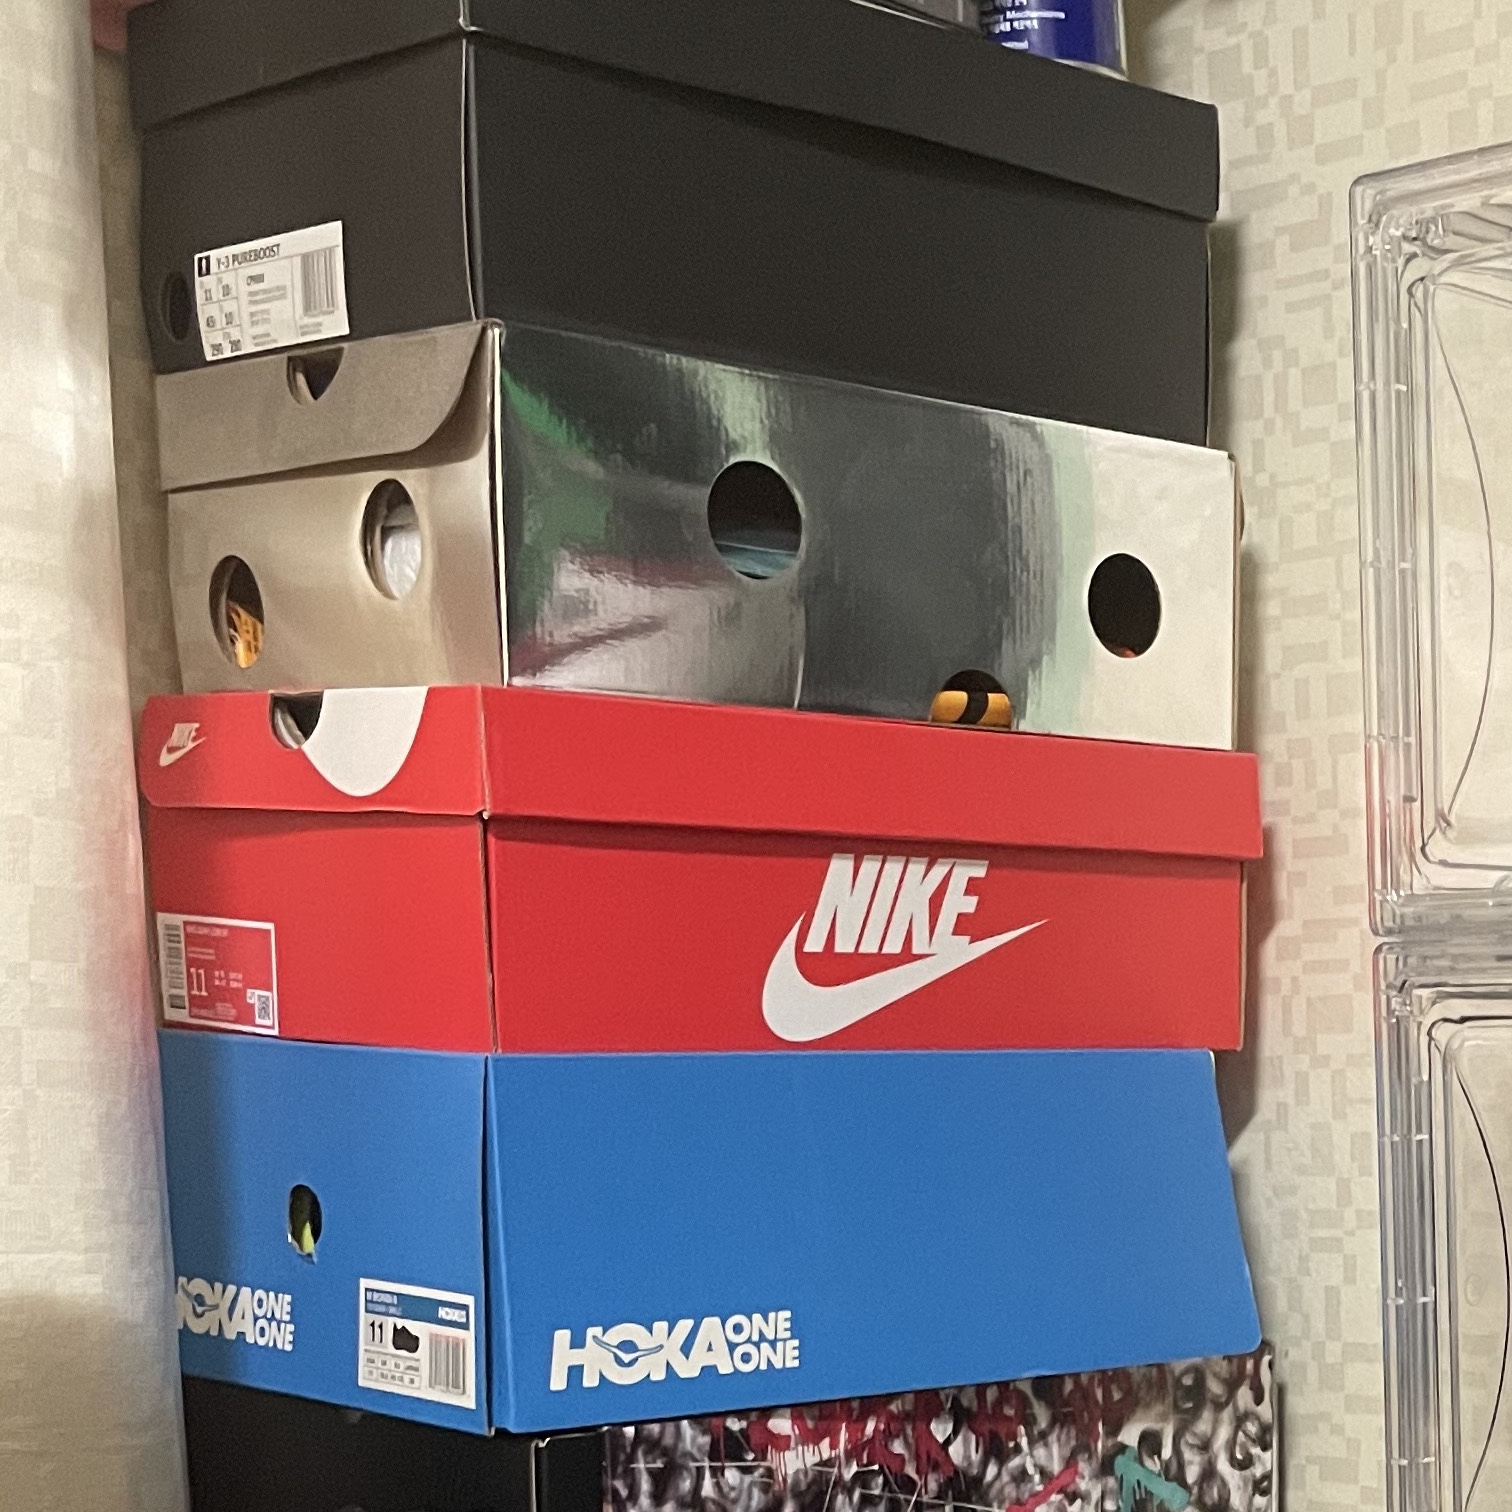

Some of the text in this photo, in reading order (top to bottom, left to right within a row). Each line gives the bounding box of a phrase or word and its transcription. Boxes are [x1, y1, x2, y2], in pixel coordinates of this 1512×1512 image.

[232, 243, 280, 266] PUREBOOST
[803, 853, 989, 955] NIKE
[190, 967, 208, 996] 11
[253, 1289, 292, 1321] ONE
[255, 1318, 295, 1351] ONE
[369, 1320, 383, 1343] 11
[550, 1310, 791, 1391] HOKA ONE
[733, 1339, 799, 1372] ONE
